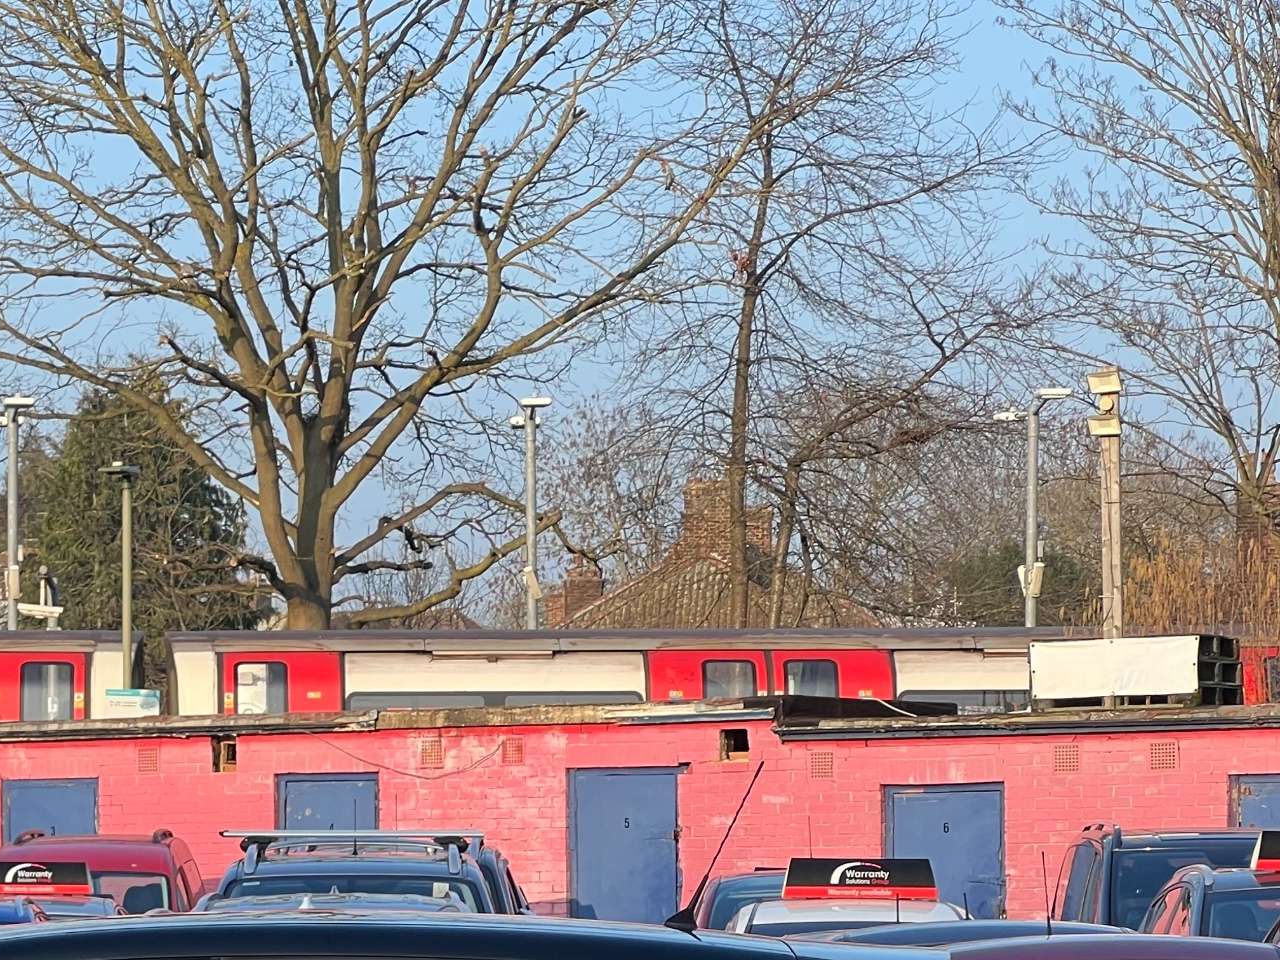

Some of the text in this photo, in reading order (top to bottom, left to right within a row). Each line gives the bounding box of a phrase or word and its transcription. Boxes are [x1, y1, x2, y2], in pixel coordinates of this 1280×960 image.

[624, 818, 630, 828] 5
[943, 822, 949, 833] 6
[18, 870, 52, 879] Warranty
[846, 869, 889, 881] Warranty
